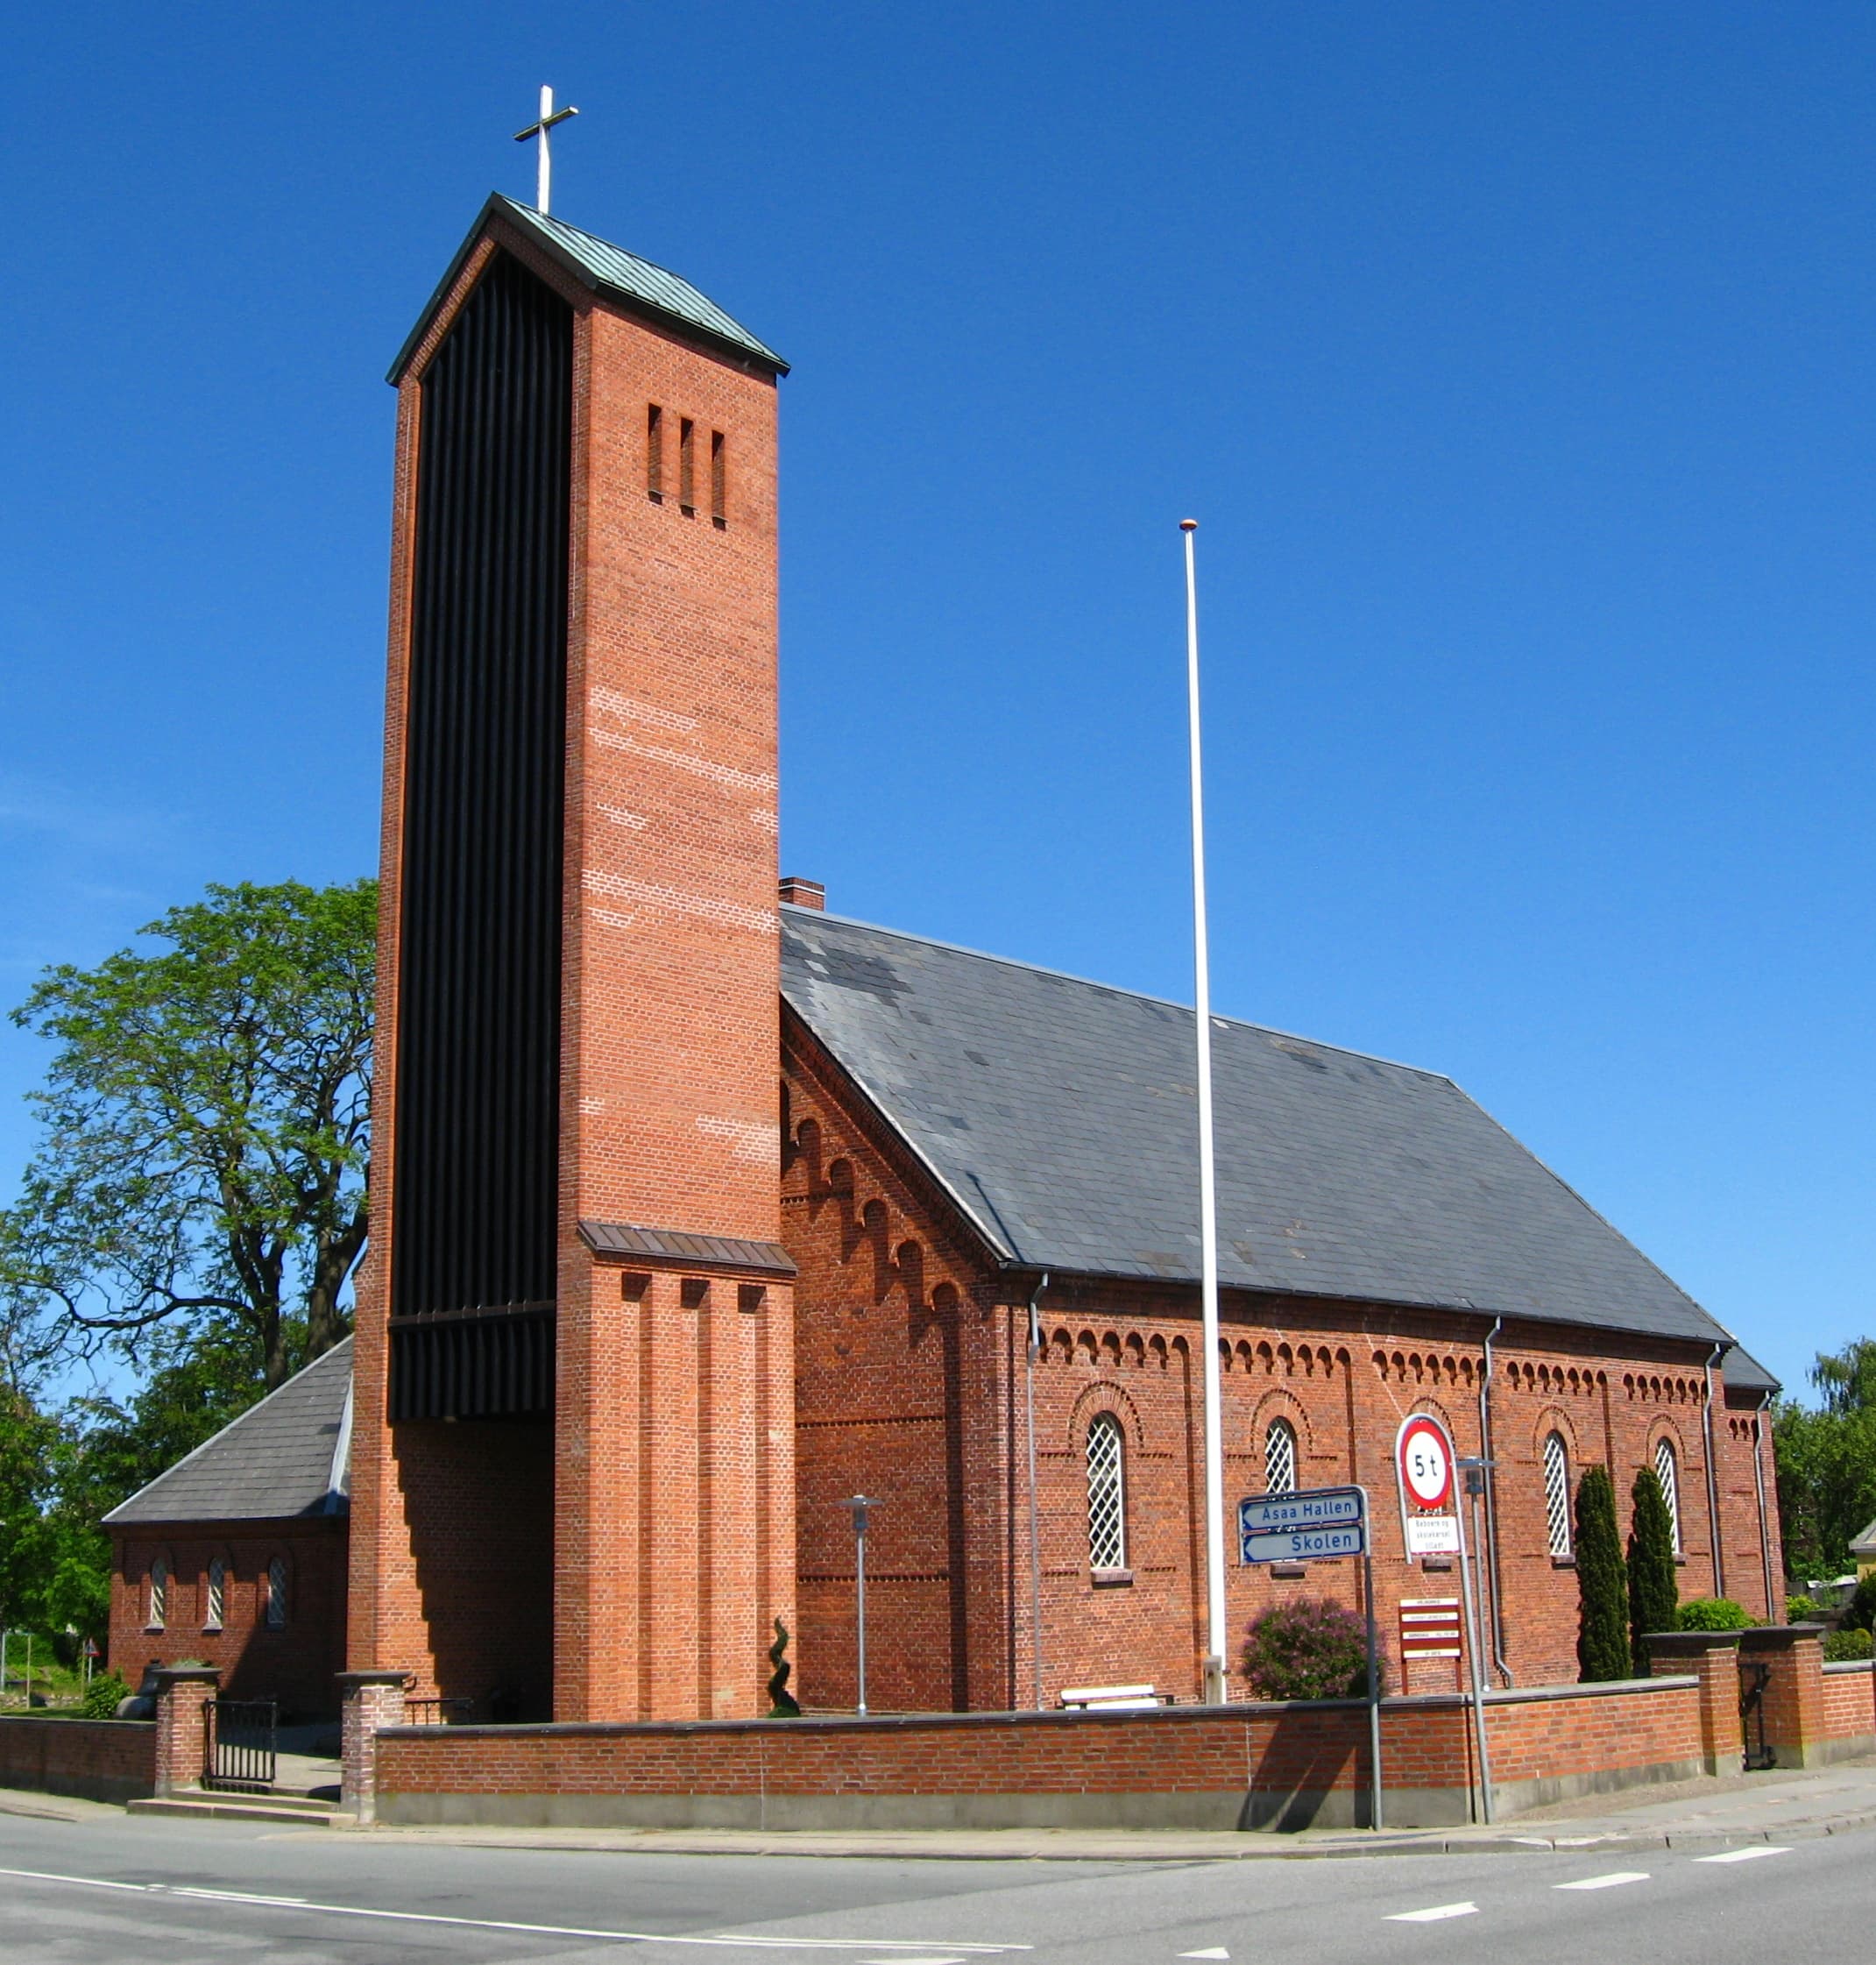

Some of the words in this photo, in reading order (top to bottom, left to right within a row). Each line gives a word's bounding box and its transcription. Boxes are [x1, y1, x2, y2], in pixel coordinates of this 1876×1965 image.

[1415, 1454, 1425, 1478] 5
[1430, 1454, 1438, 1477] t
[1262, 1507, 1298, 1521] Asaa
[1303, 1501, 1352, 1517] Hallen
[1292, 1534, 1352, 1551] Skolen
